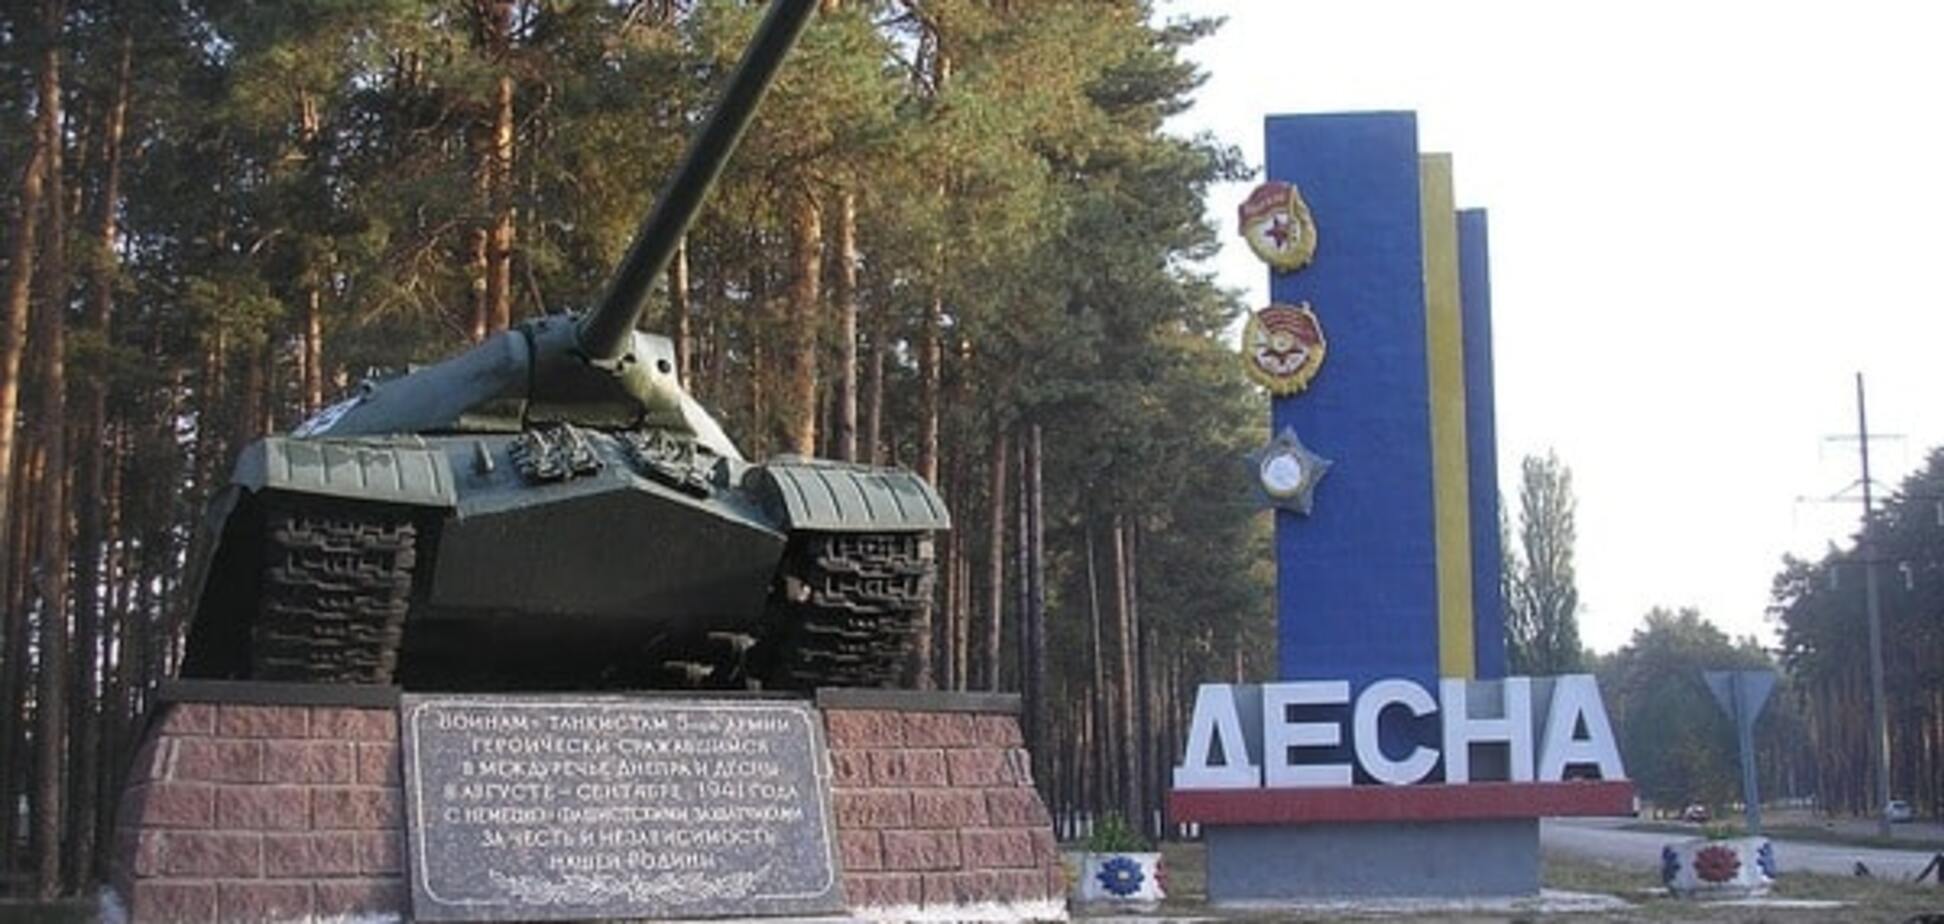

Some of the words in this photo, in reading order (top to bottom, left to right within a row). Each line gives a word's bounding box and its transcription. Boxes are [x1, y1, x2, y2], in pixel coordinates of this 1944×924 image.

[549, 714, 668, 731] ТАНКИСТАМ
[1173, 674, 1627, 789] ДЕСНА
[473, 737, 610, 753] ГЕРОИЧЕСКИ
[618, 737, 769, 754] СРАЖАВШИМСЯ
[479, 760, 612, 779] МЕЖДУРЕЧЬЕ
[618, 759, 692, 777] ДНЕПРА
[461, 784, 554, 800] АВГУСТЕ
[700, 781, 743, 798] 1941
[508, 829, 575, 847] ЧЕСТЬ
